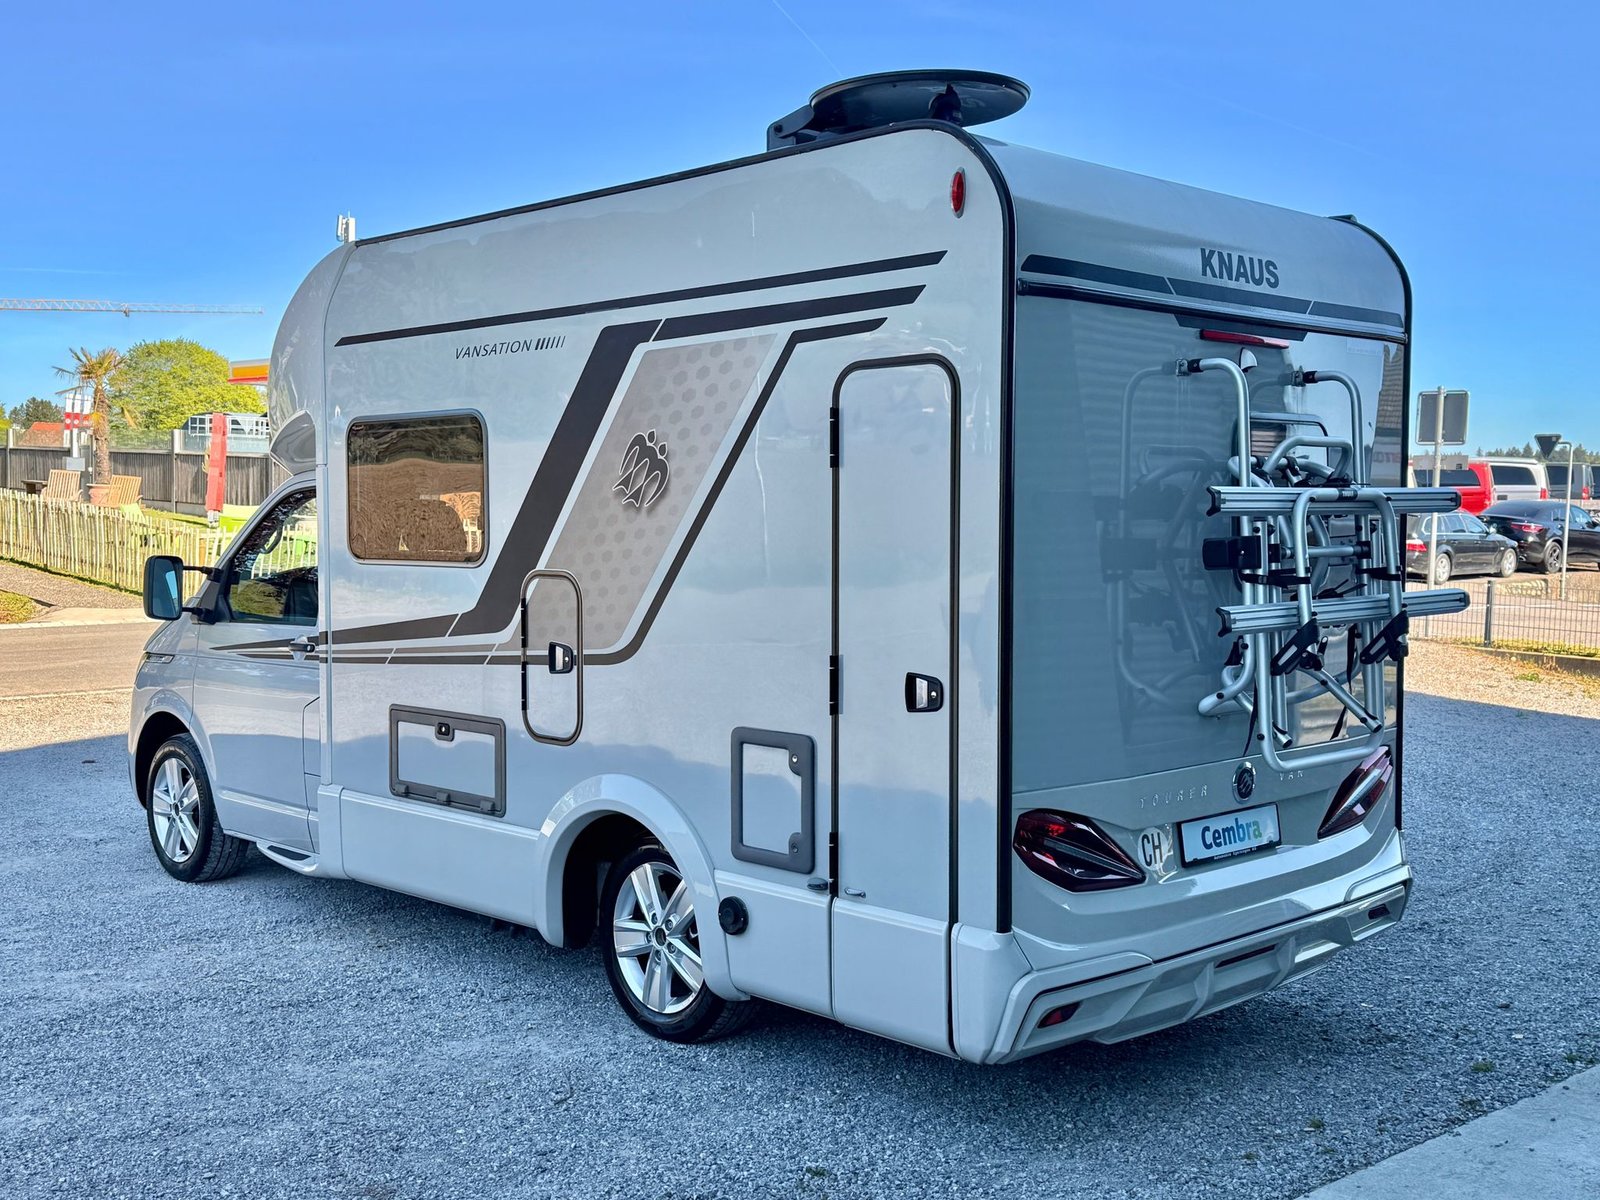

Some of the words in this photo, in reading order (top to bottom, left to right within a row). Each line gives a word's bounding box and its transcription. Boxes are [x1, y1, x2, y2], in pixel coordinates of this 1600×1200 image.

[1200, 247, 1280, 289] KNAUS
[455, 339, 533, 360] VANSATION
[1139, 784, 1208, 809] TOURER
[1279, 770, 1304, 781] VAN
[1141, 833, 1163, 867] CH
[1201, 817, 1263, 850] Cembra
